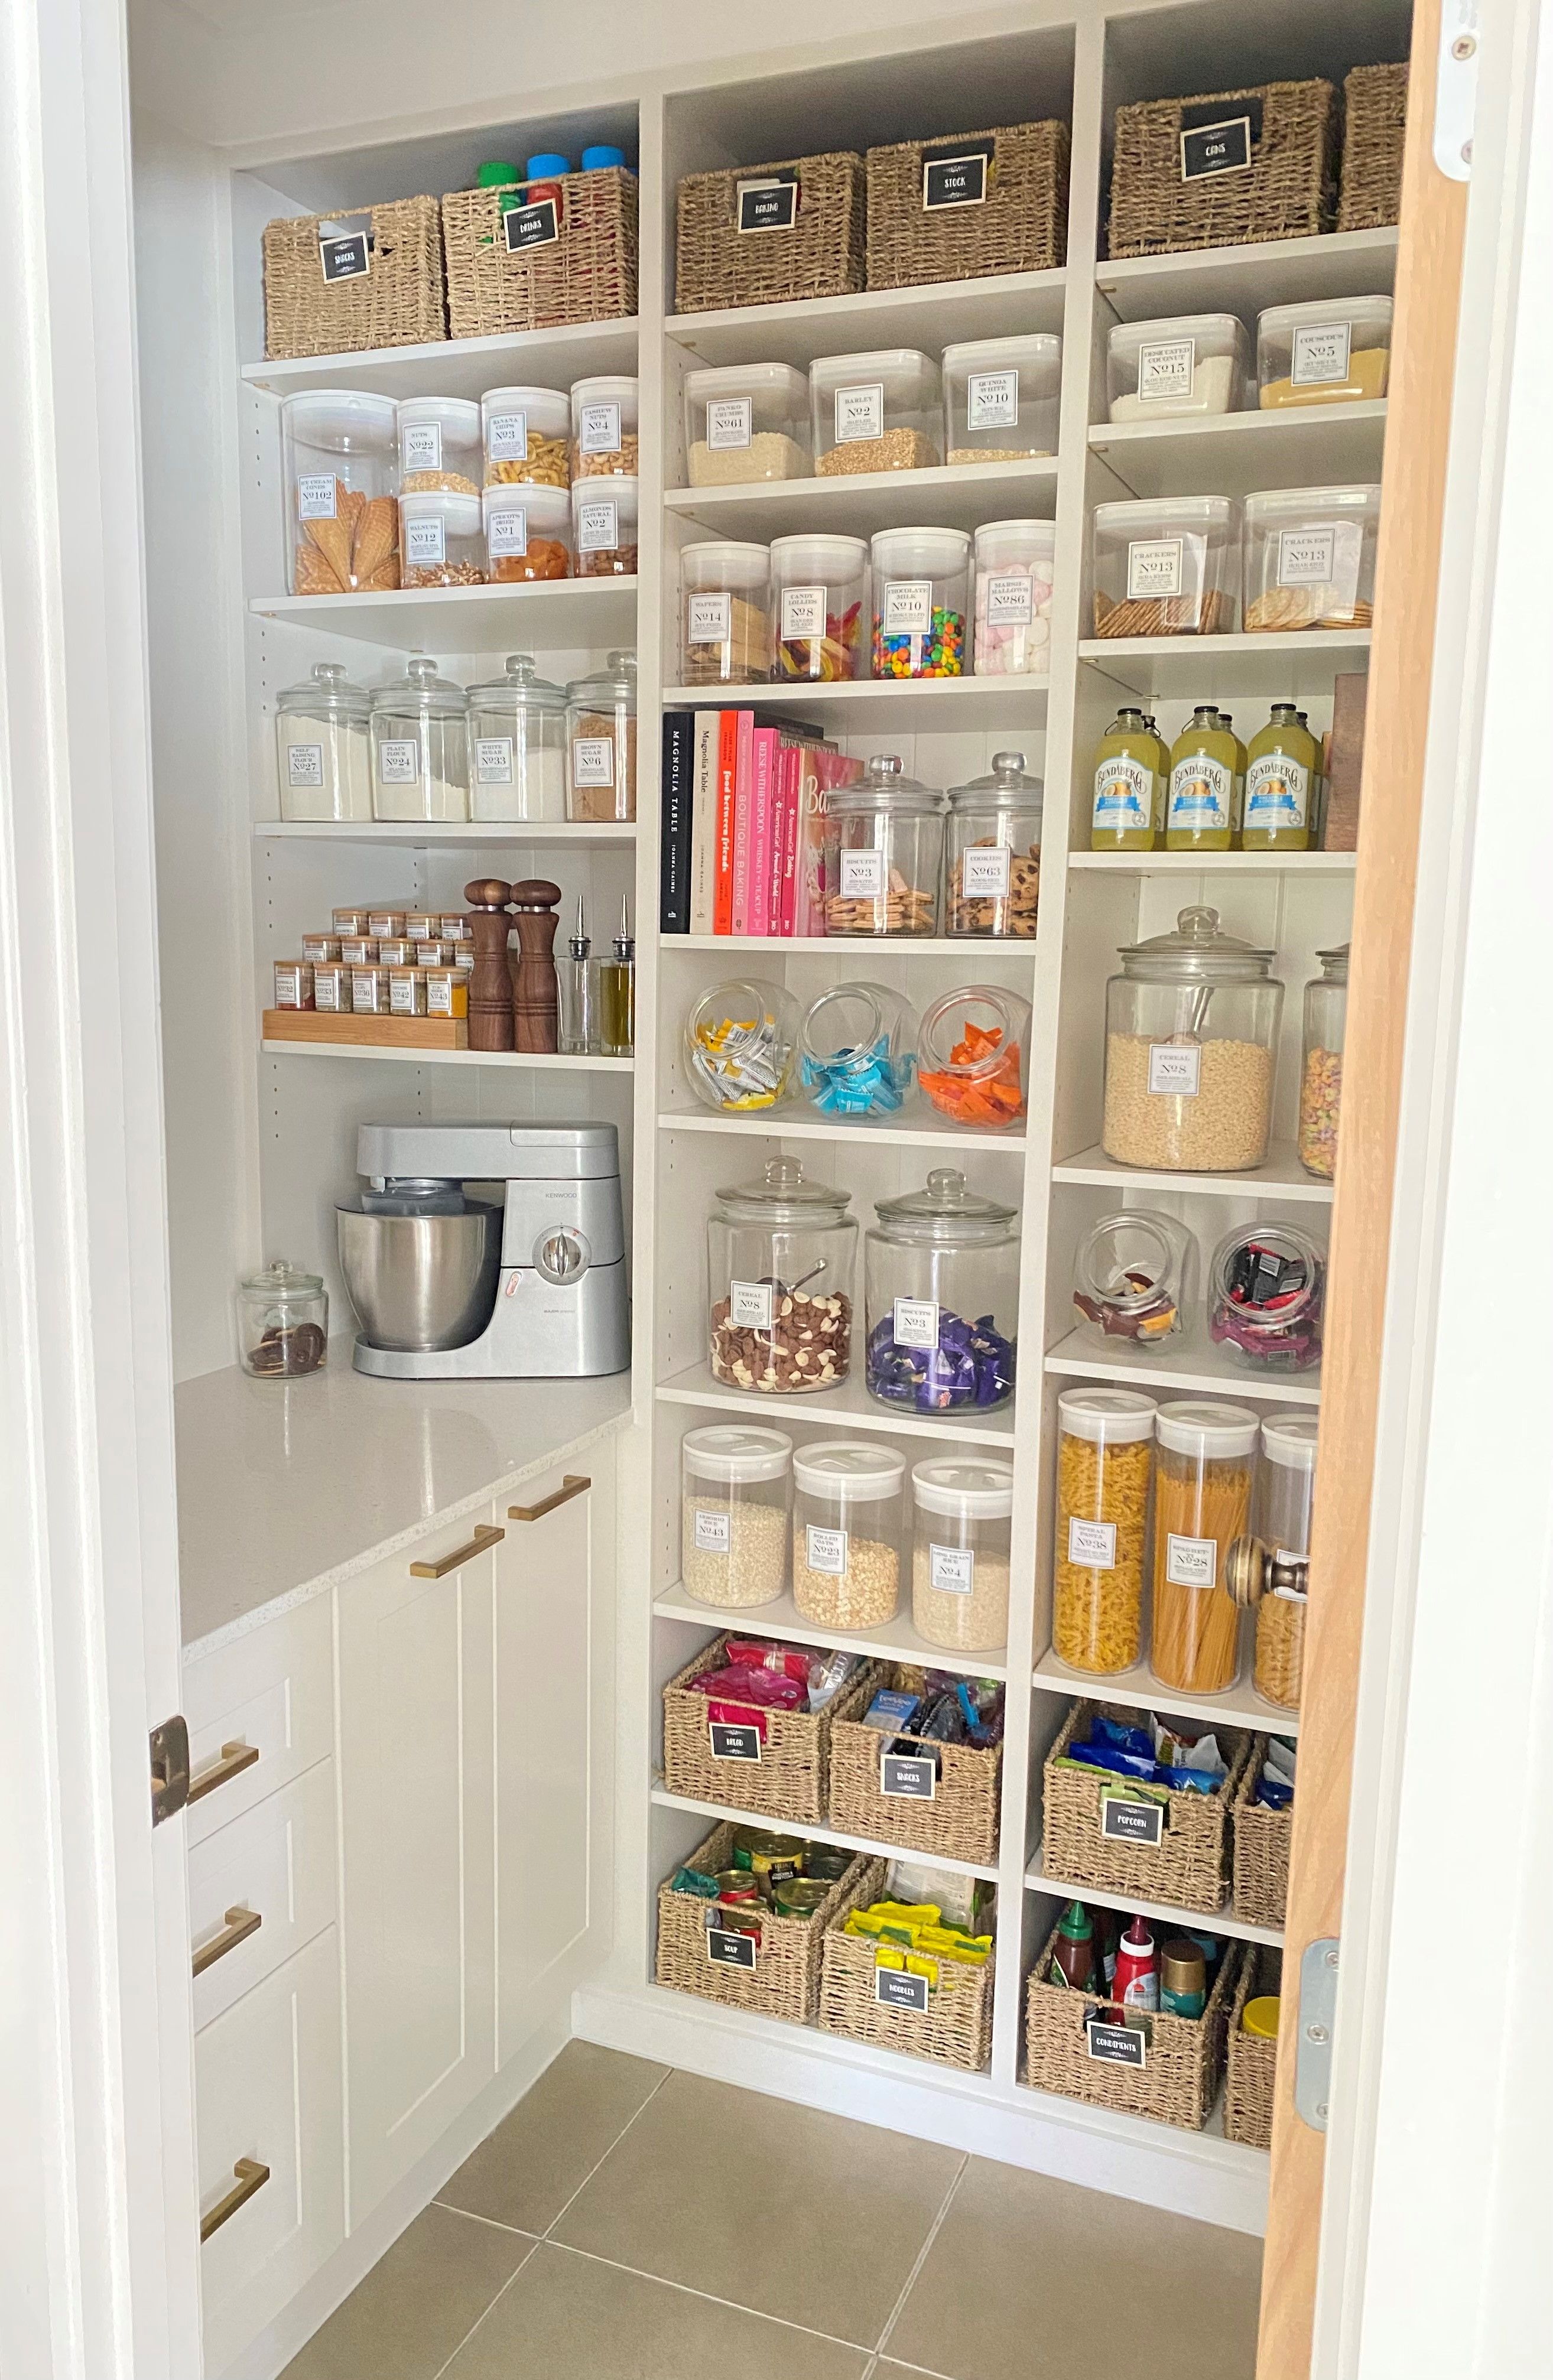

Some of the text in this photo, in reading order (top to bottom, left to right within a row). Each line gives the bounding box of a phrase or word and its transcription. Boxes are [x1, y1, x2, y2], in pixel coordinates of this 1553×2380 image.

[1205, 142, 1226, 157] CANS
[944, 177, 966, 189] STOCK
[519, 220, 542, 233] DRINKS
[1299, 334, 1344, 344] COUSCOUS
[1148, 354, 1185, 363] COCONUT
[979, 379, 1007, 388] QUINOA
[844, 396, 873, 405] BARLEY
[1284, 537, 1331, 547] CRACKERS
[1135, 550, 1177, 560] CRACKERS
[700, 730, 710, 793] Magnolia Table
[670, 730, 680, 833] MAGNOLIA TABLE
[723, 770, 732, 793] food
[1096, 764, 1145, 793] BUNDABERG
[1172, 763, 1225, 793] BUNDABERG
[1249, 762, 1301, 792] BUNDABERG
[756, 741, 767, 834] REESE WITHERSPOON
[722, 794, 732, 835] between
[721, 837, 730, 873] friends
[736, 794, 747, 906] BOUTIQUE BAKING
[784, 855, 794, 878] Baking
[754, 838, 763, 915] WHISKEY TEACUP
[1117, 1815, 1148, 1828] POPCORN
[724, 1945, 738, 1955] SOUP
[889, 1984, 915, 1997] NOODLES
[1095, 2037, 1136, 2053] CONDIMENTS
